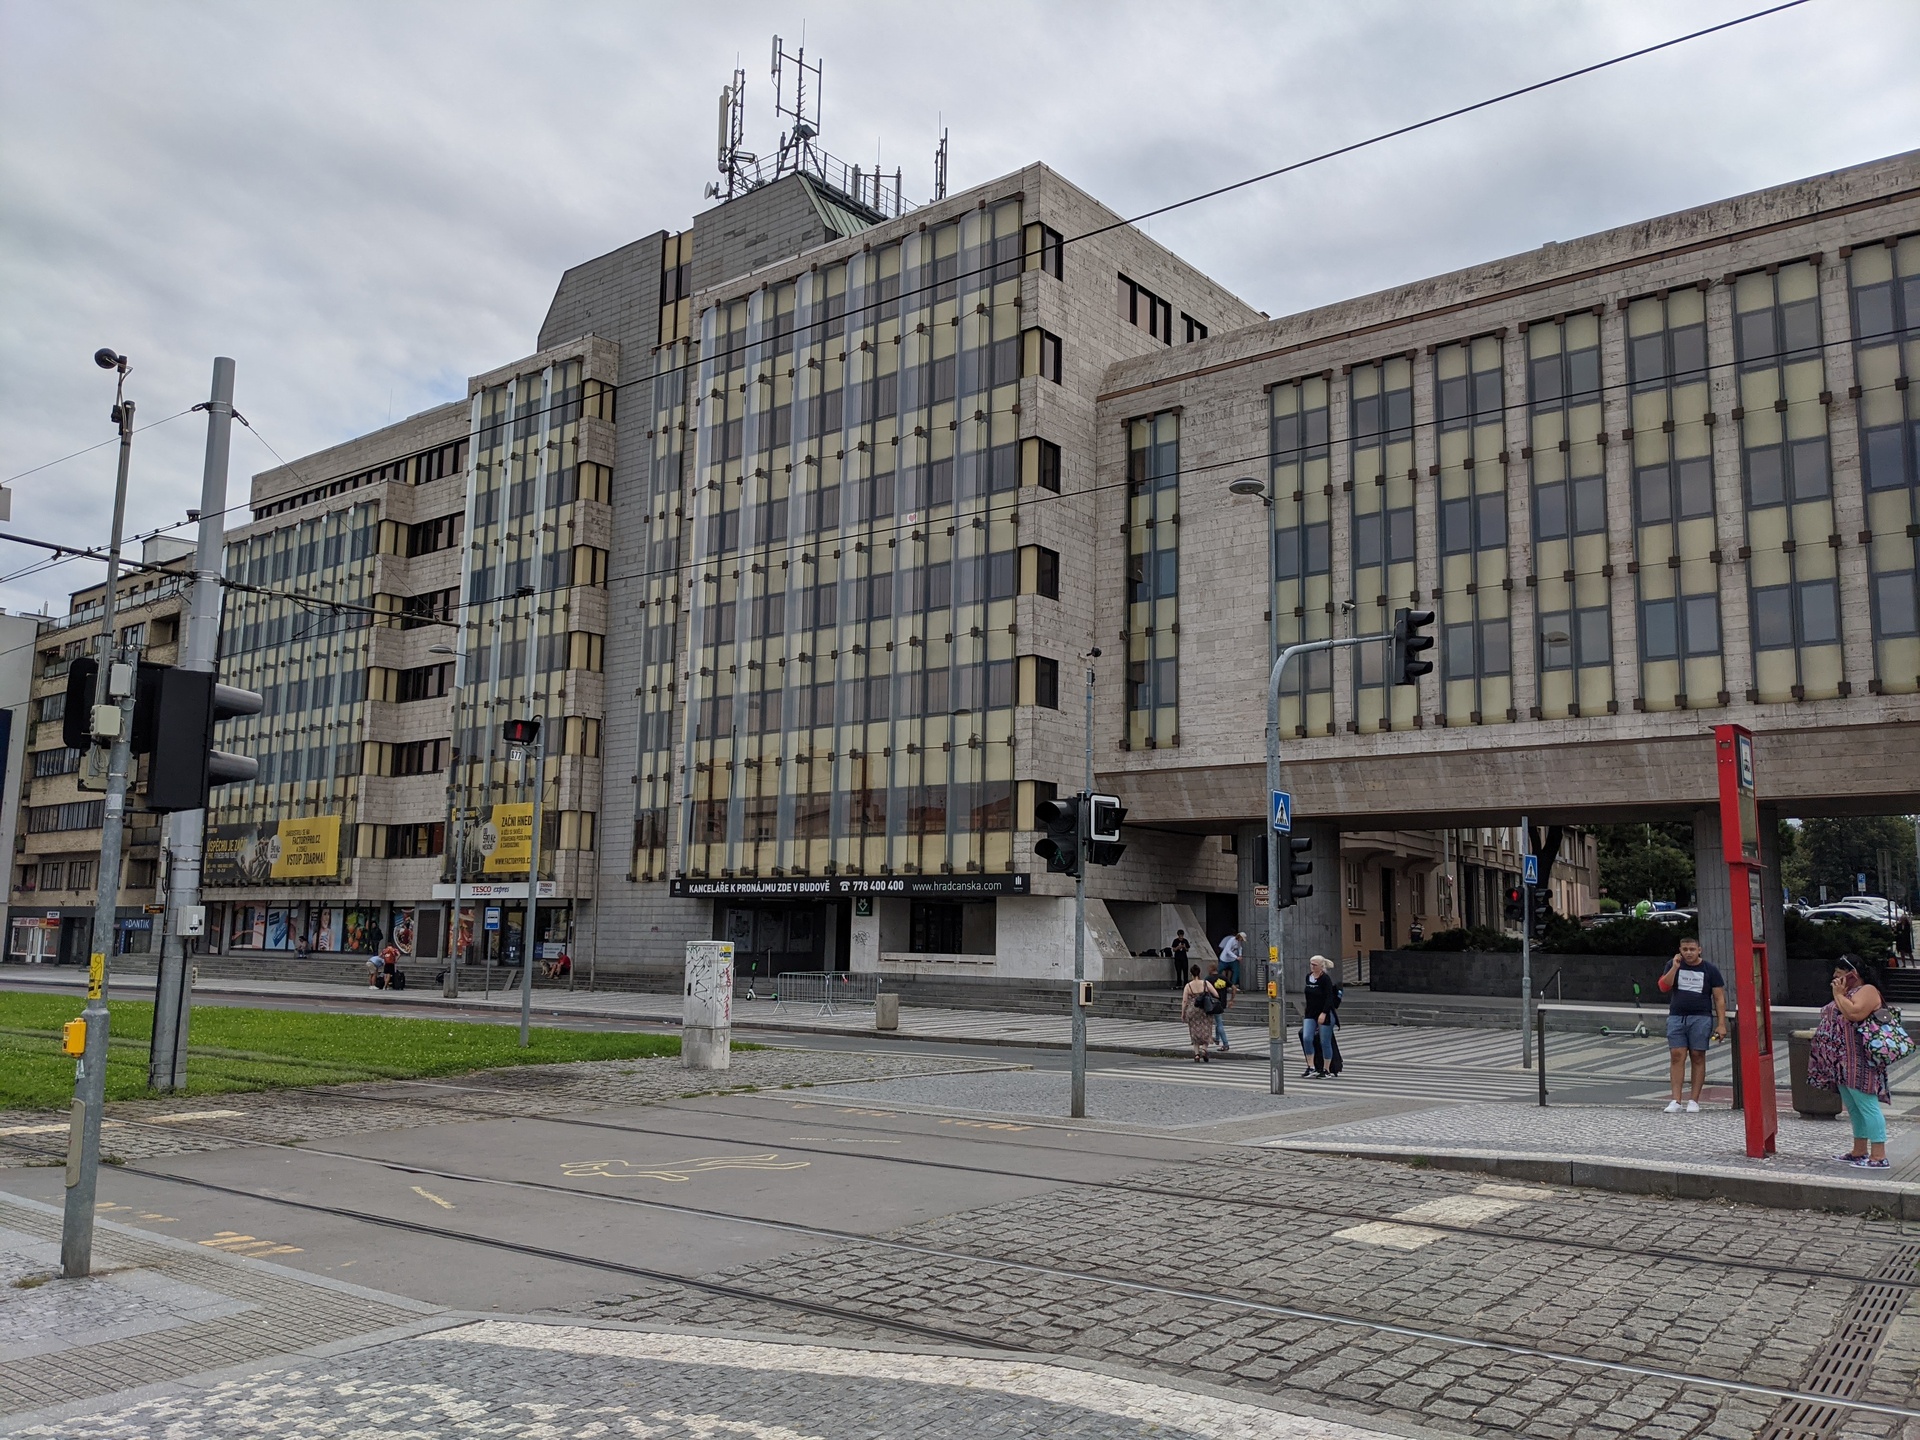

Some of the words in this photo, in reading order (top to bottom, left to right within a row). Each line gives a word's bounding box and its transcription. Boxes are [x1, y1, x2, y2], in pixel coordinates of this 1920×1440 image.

[501, 814, 516, 827] ZAČNI
[517, 815, 532, 826] HNED
[207, 838, 228, 852] ÚSPĚCHU
[228, 839, 234, 852] JE
[286, 853, 302, 865] VSTUP
[303, 852, 326, 865] ZDARMA!
[495, 857, 532, 865] WWW.FACTORYPRO.C
[493, 886, 509, 894] expres
[689, 881, 729, 893] KANCELÁŘE
[730, 883, 736, 893] K
[737, 881, 777, 893] PRONÁJMU
[777, 882, 792, 892] ZDE
[793, 882, 799, 892] V
[800, 879, 830, 892] BUDOVĚ
[853, 880, 869, 891] 778
[870, 880, 887, 891] 400
[887, 880, 904, 891] 400
[912, 880, 1002, 891] www.hradcanska.com
